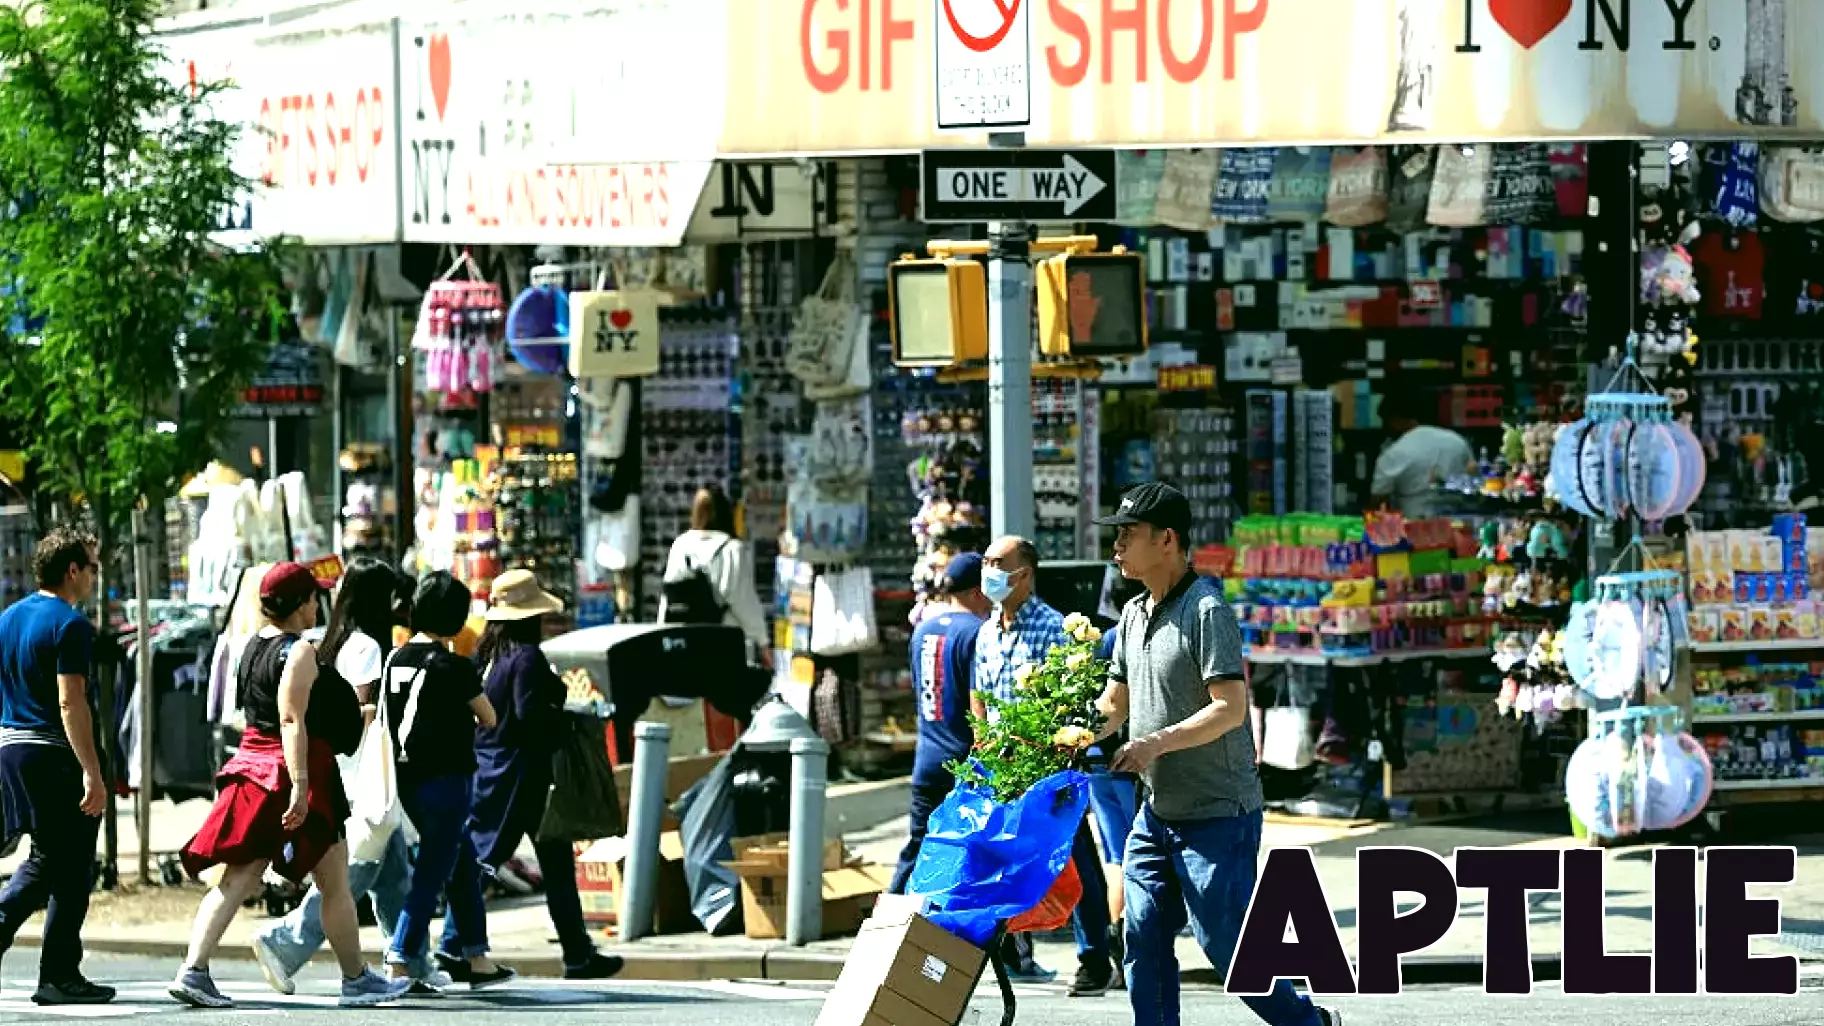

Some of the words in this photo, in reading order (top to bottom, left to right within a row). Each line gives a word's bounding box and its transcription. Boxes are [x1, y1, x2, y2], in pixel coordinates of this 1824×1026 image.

[1044, 0, 1269, 87] SHOP
[325, 86, 383, 186] SHOP
[411, 139, 455, 225] NY
[952, 171, 1007, 199] ONE
[1033, 171, 1088, 199] WAY
[597, 309, 608, 329] I
